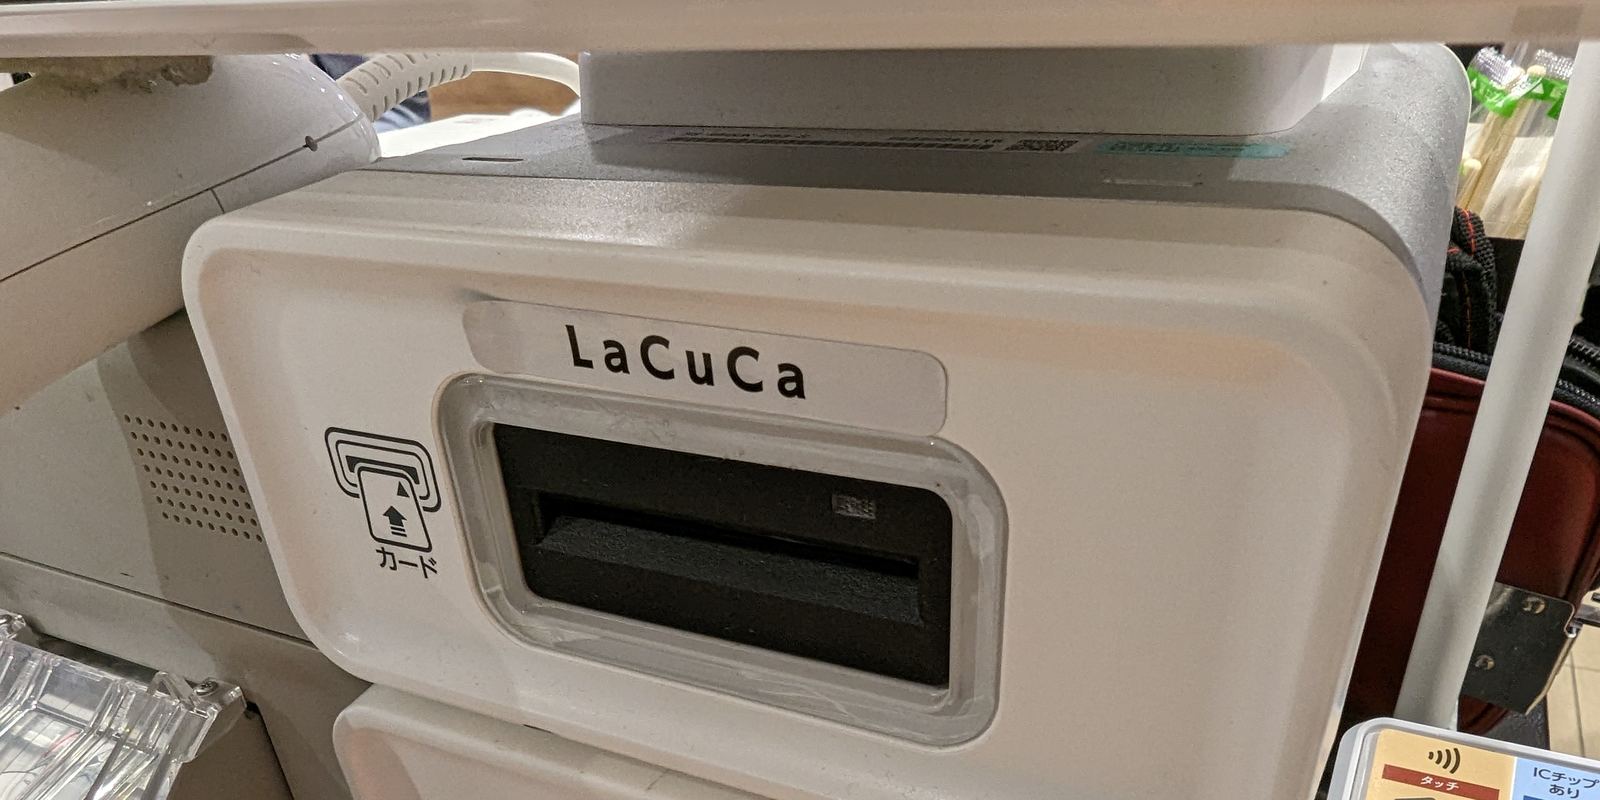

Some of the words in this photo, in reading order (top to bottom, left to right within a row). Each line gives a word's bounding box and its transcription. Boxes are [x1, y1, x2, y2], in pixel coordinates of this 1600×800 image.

[565, 324, 806, 400] LaCuCa
[376, 546, 438, 579] カード
[1420, 775, 1459, 792] タッチ
[1533, 767, 1600, 788] ICチップ
[1549, 784, 1579, 799] あり
